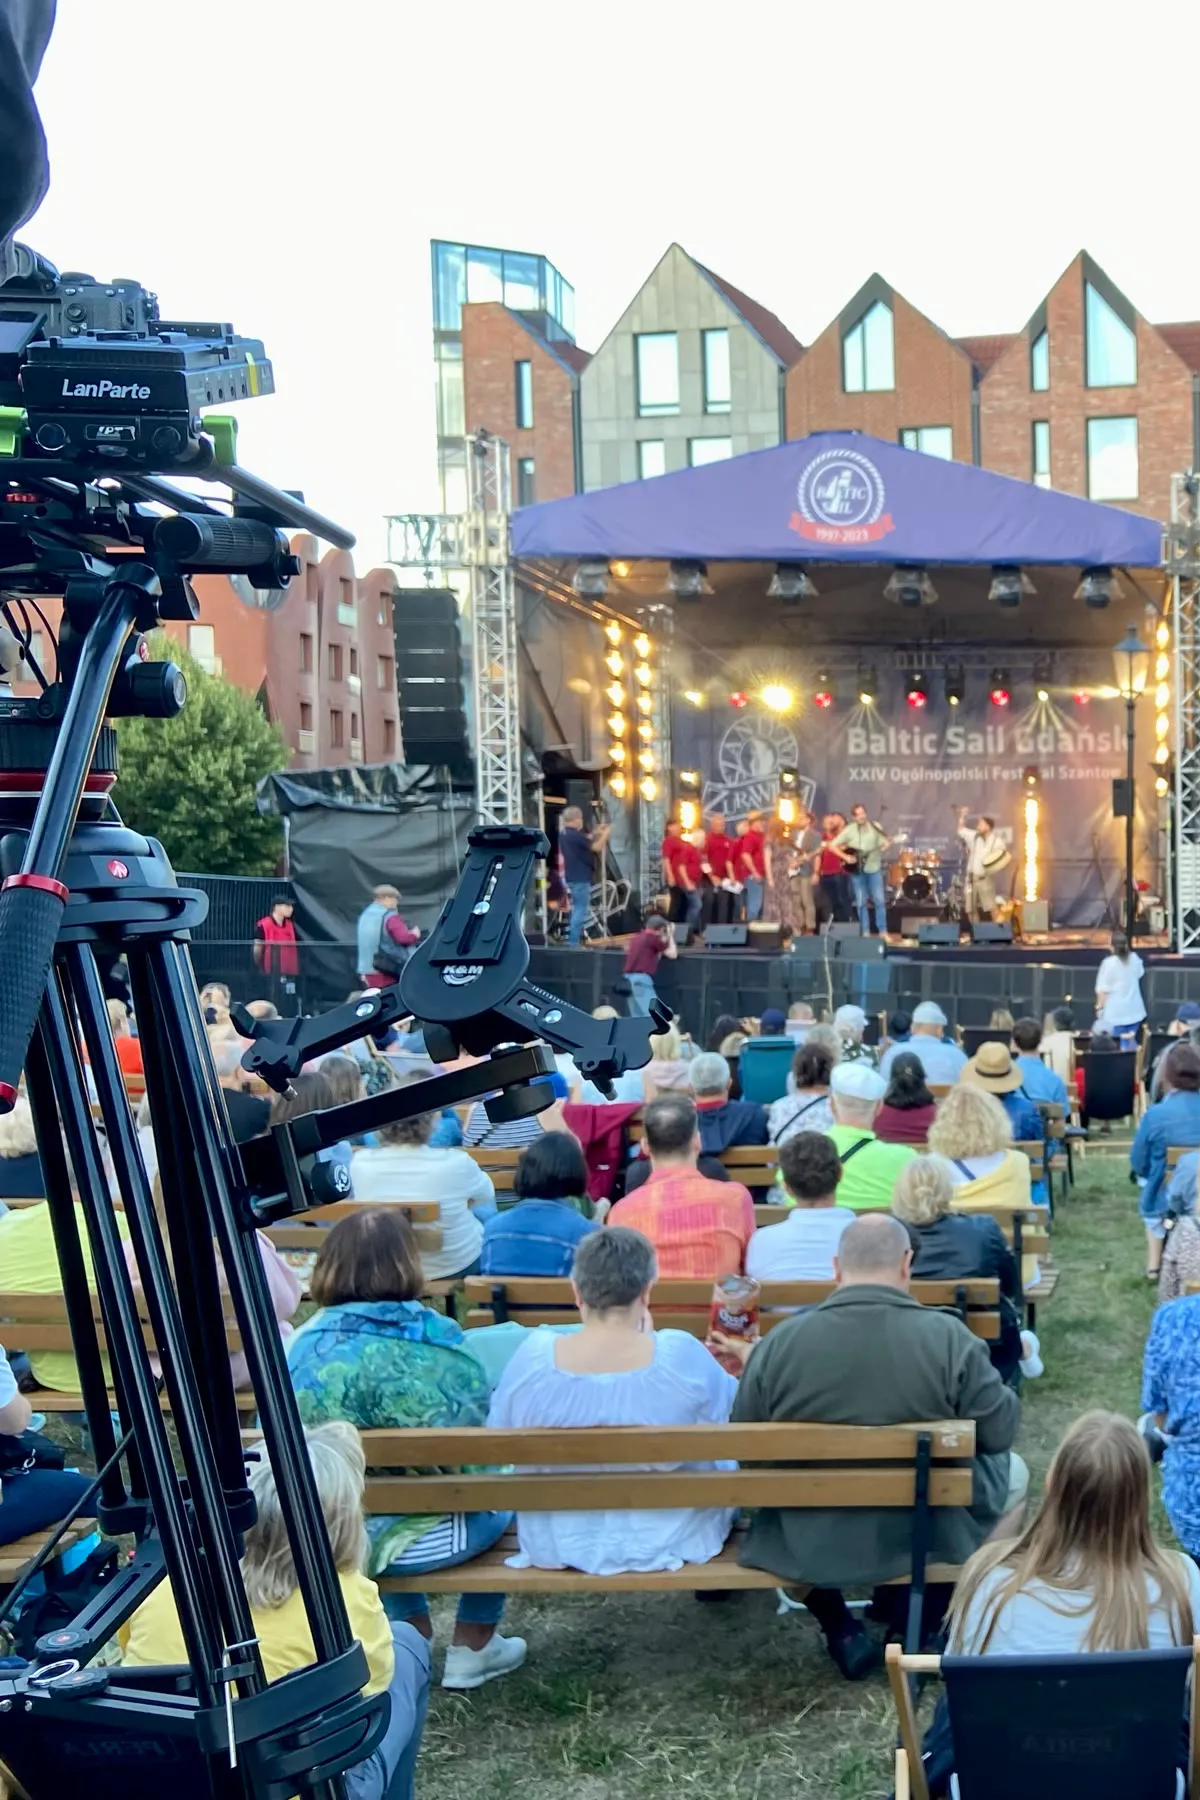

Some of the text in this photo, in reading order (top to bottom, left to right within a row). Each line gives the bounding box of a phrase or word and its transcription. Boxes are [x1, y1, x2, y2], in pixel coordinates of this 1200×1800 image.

[62, 379, 151, 400] LanParte
[816, 486, 866, 500] BTIC
[847, 726, 938, 756] Baltic
[945, 725, 1004, 755] Sail
[848, 767, 887, 782] XXIV
[890, 766, 988, 785] Ogólnopolski
[992, 765, 1054, 782] Festal
[442, 965, 484, 976] K&M
